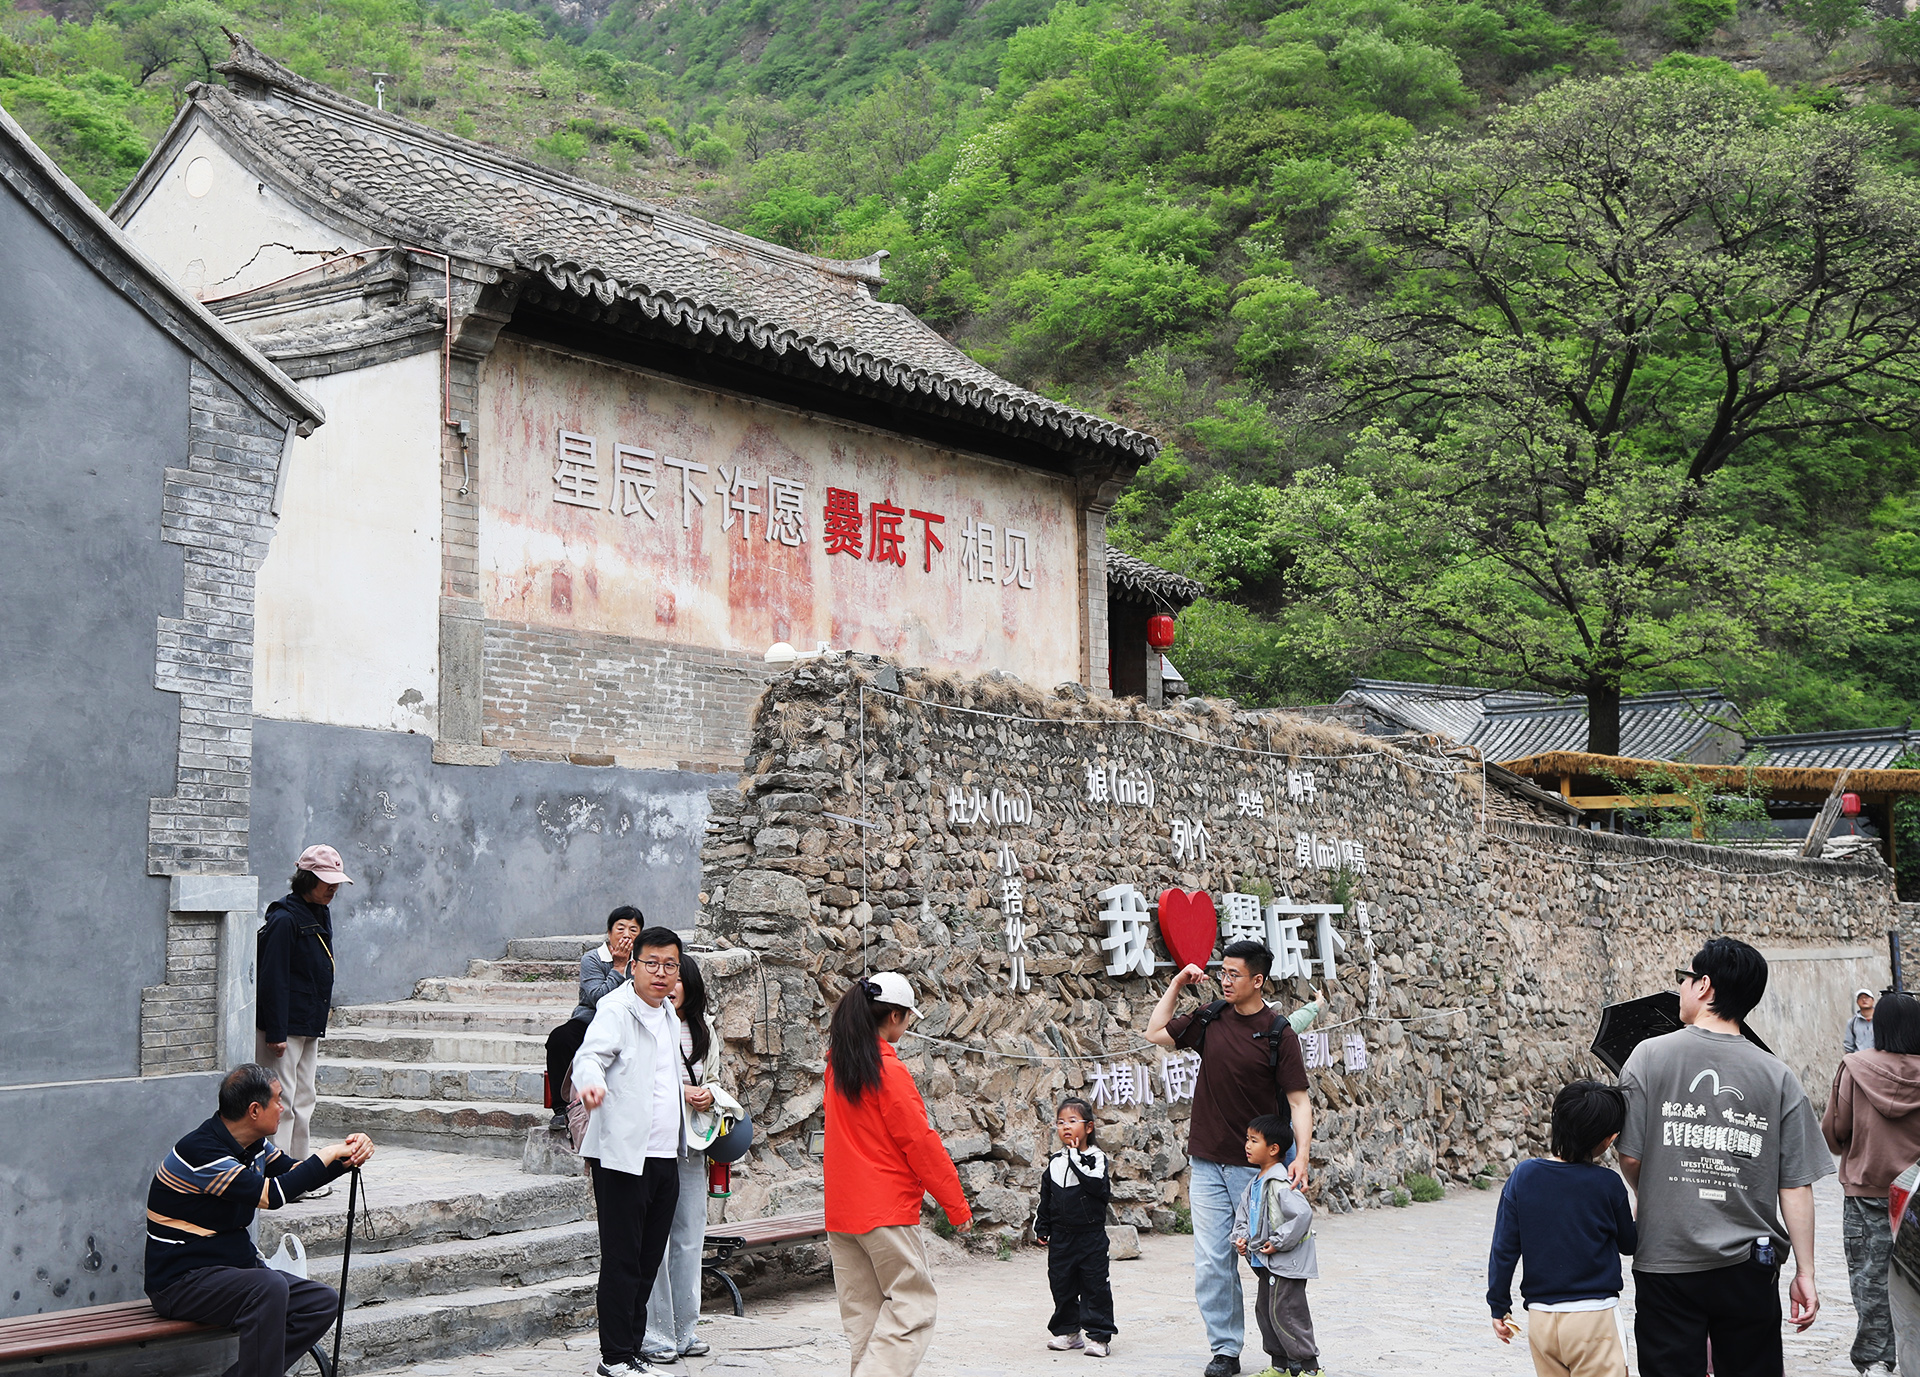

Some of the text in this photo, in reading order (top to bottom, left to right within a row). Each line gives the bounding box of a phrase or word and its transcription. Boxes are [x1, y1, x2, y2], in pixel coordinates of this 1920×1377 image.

[553, 429, 1035, 590] 星辰下许愿 爨底下 相见
[949, 787, 1033, 827] 灶火(hu)
[1171, 819, 1212, 863] 列个
[997, 842, 1031, 991] 小搭伙儿
[1098, 884, 1155, 977] 我
[1680, 1160, 1714, 1170] LIFESTYLE
[1700, 1156, 1725, 1165] FUTURE
